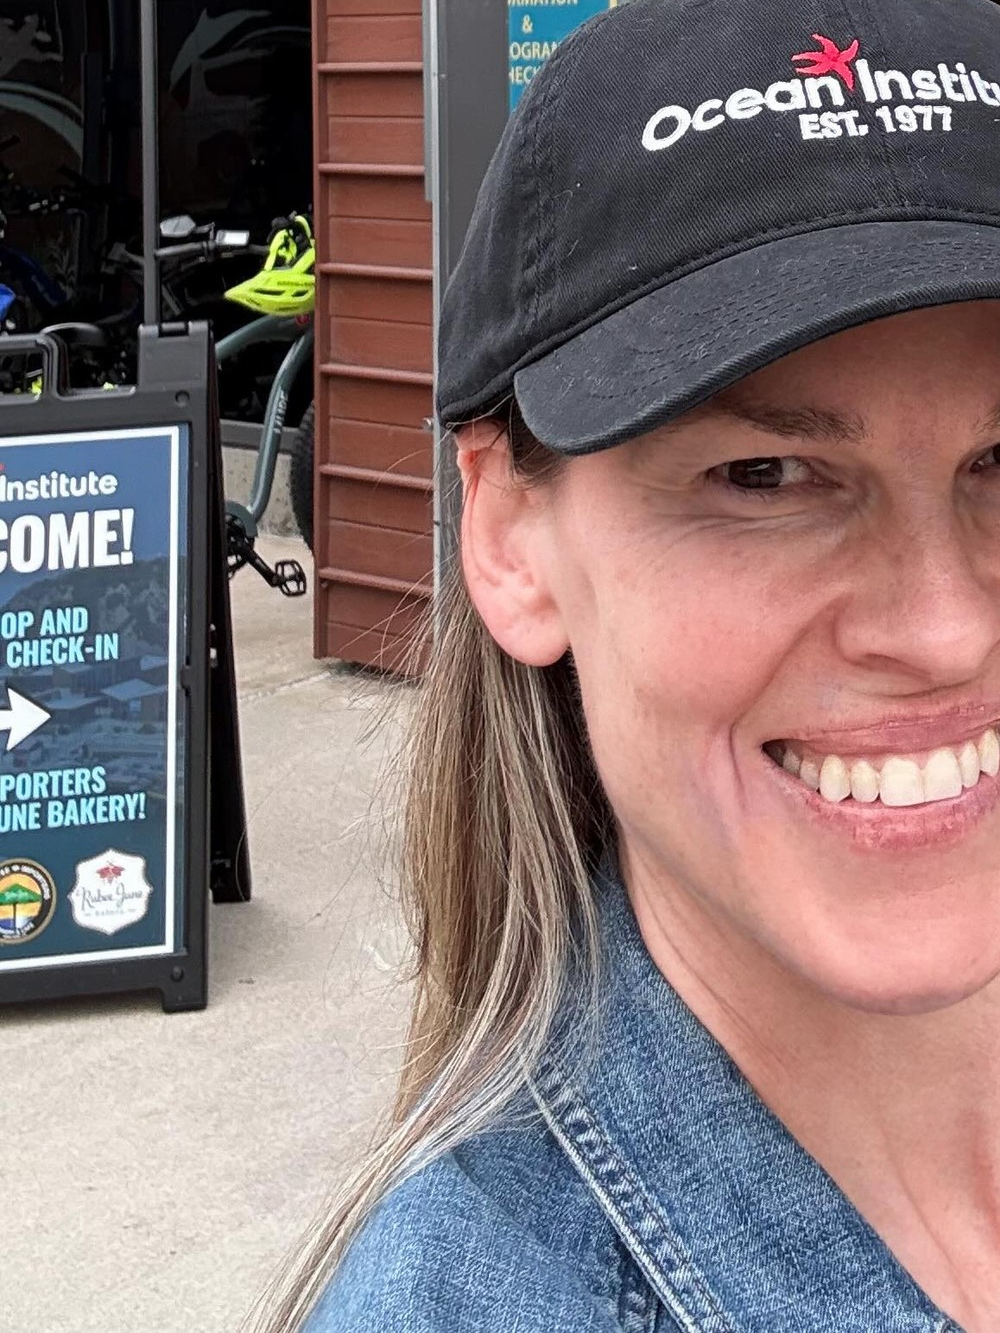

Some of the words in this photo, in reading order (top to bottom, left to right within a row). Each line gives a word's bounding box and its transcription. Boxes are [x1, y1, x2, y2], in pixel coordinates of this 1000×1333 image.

[522, 14, 533, 33] &
[641, 75, 843, 152] Ocean
[799, 109, 869, 141] EST.
[876, 105, 953, 134] 1977
[0, 471, 118, 502] Institute
[1, 611, 34, 639] OP
[40, 607, 88, 636] AND
[6, 633, 119, 668] CHECK-IN
[0, 766, 106, 803] PORTERS
[47, 792, 146, 828] BAKERY!
